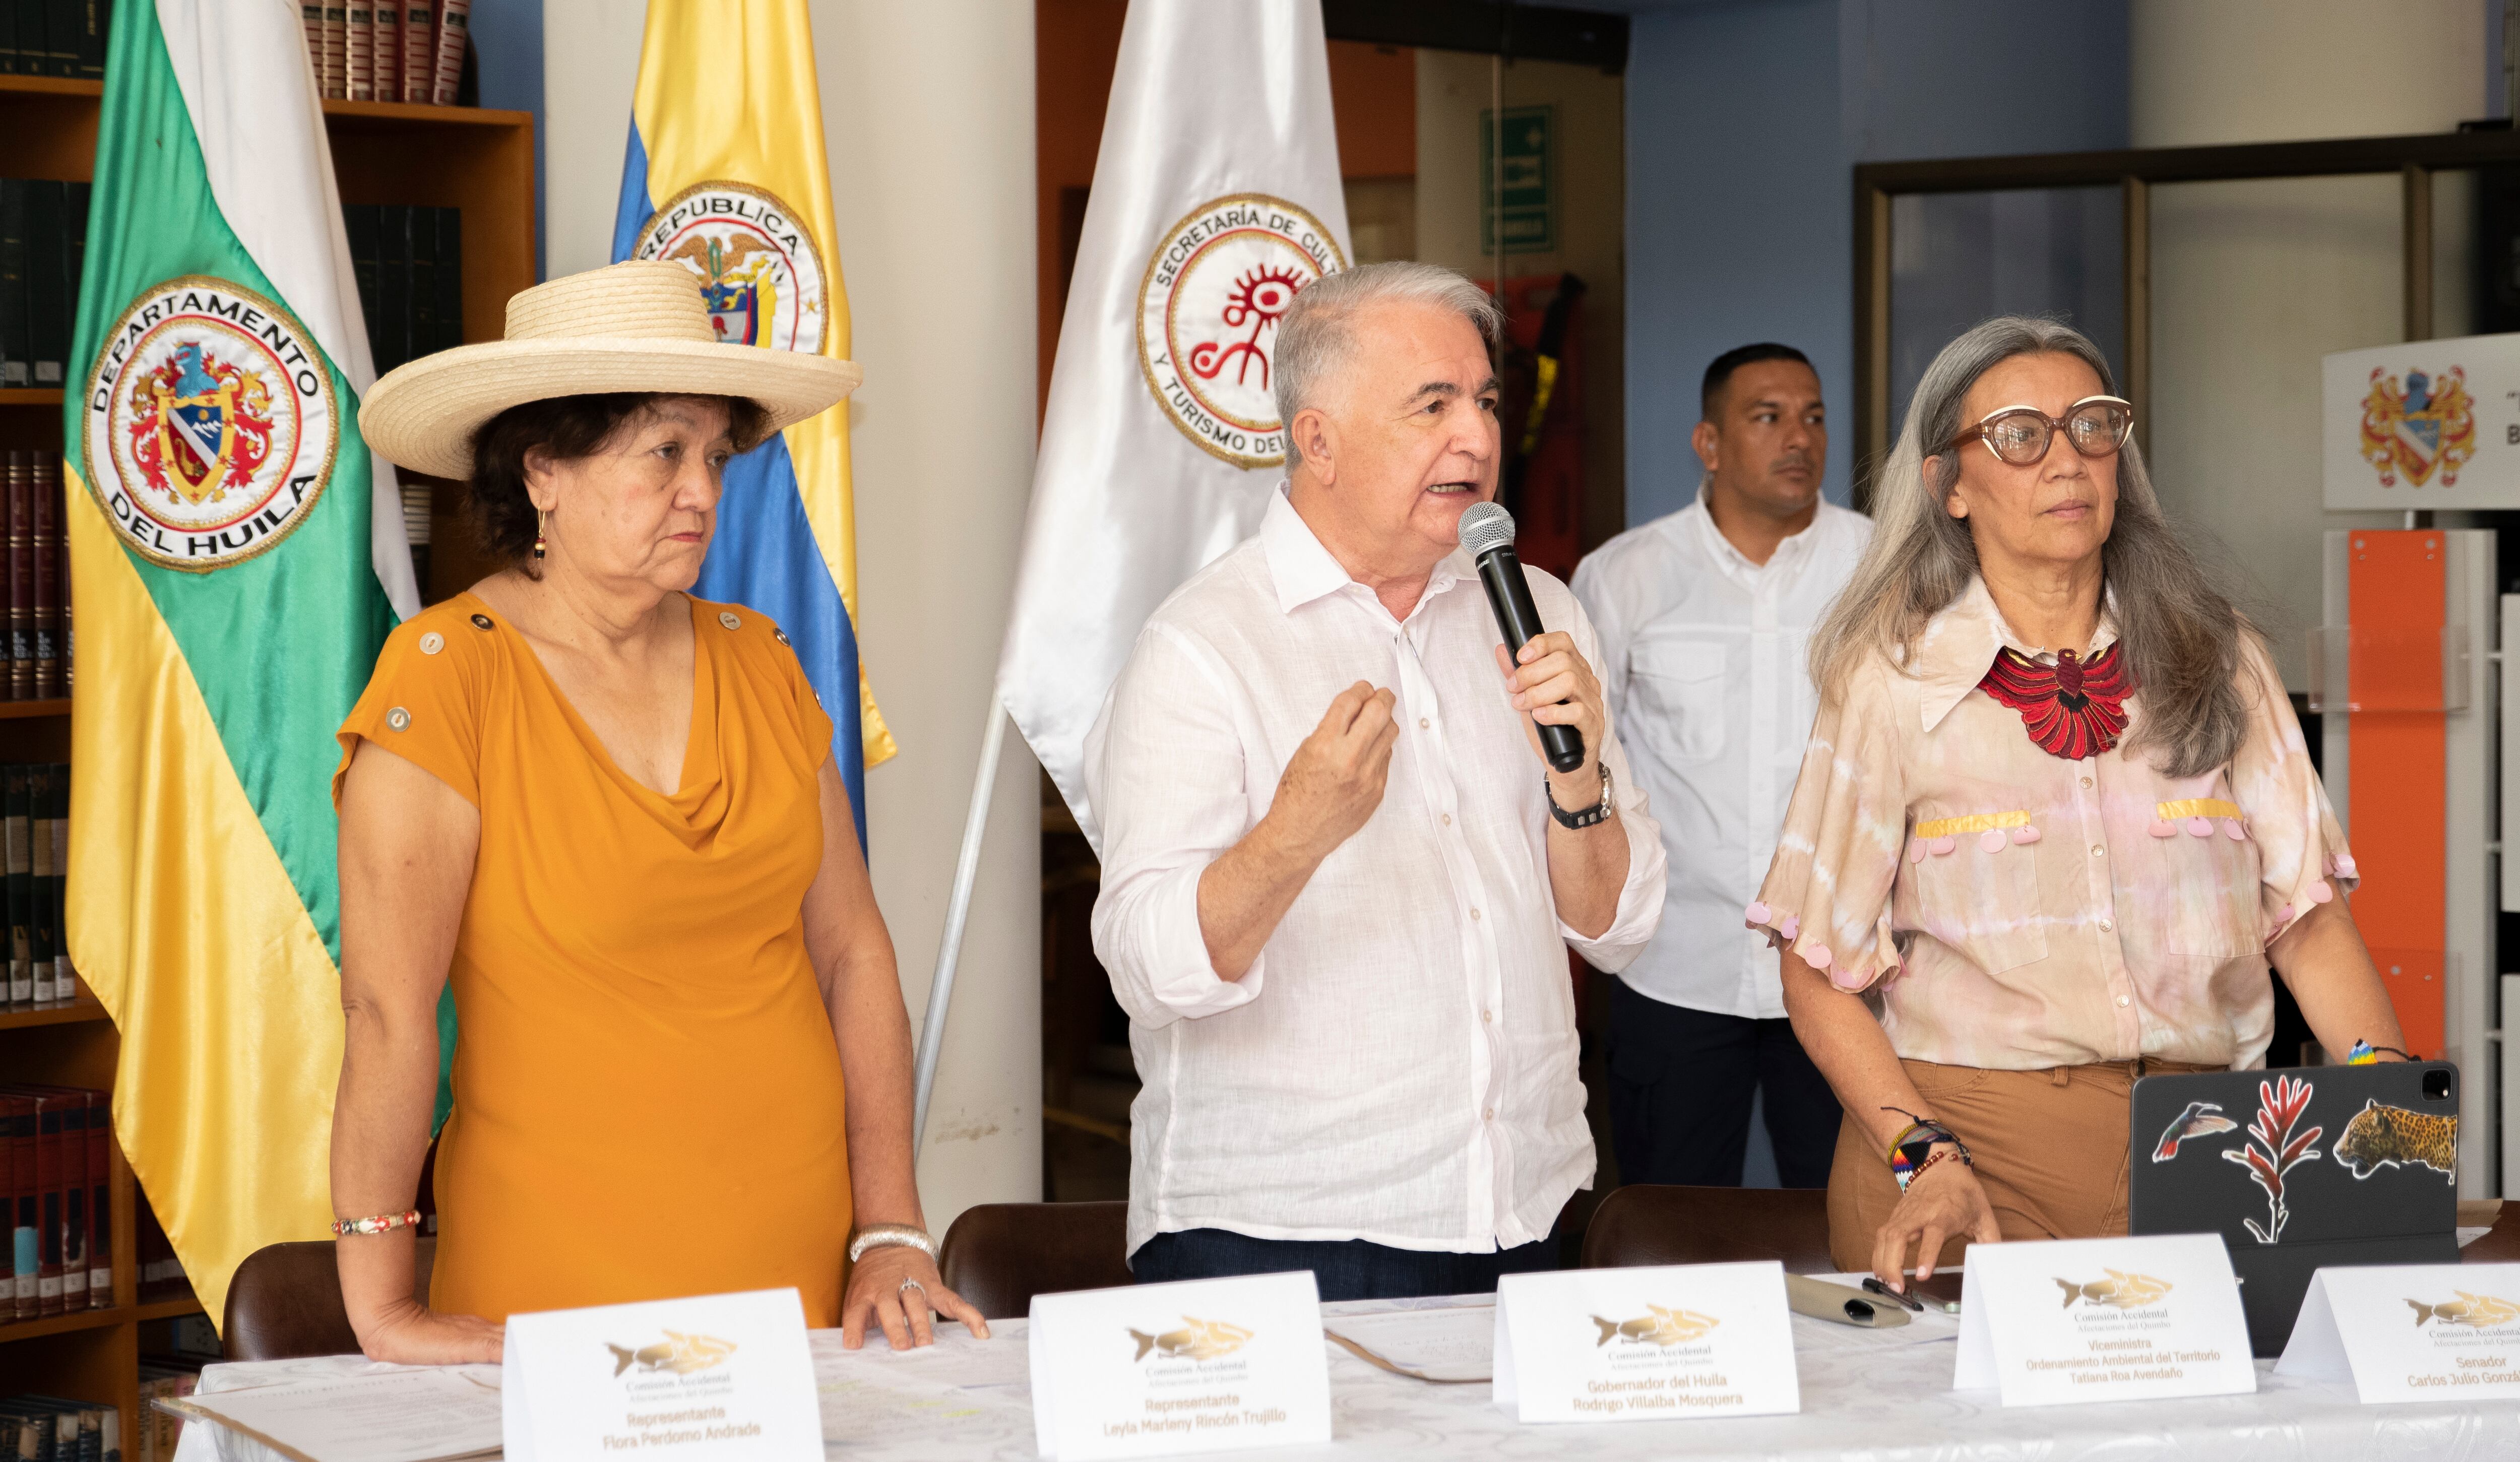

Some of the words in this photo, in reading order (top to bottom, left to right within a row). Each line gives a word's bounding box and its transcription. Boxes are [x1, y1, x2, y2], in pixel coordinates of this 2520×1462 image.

[640, 199, 798, 260] REPUBLICA
[1157, 204, 1261, 287] SECRETARÍA
[1269, 214, 1296, 236] DE
[94, 293, 319, 412] DEPARTAMENTO
[1155, 352, 1169, 366] Y
[1164, 377, 1245, 451] TURISMO
[111, 491, 173, 553] DEL
[188, 475, 317, 556] HUILA
[2074, 1311, 2118, 1322] Comisión
[2121, 1309, 2168, 1320] Accidental
[2077, 1324, 2125, 1333] Afectaciones
[2127, 1322, 2138, 1330] del
[2140, 1320, 2171, 1330] Quimbo
[2429, 1329, 2473, 1339] Comisión
[2476, 1327, 2520, 1337] Accidenta
[1608, 1350, 1656, 1361] Comisión
[1659, 1346, 1711, 1357] Accidental
[2088, 1338, 2152, 1351] Viceministra
[1146, 1363, 1192, 1377] Comisión
[1195, 1360, 1246, 1373] Accidental
[2027, 1356, 2099, 1371] Ordenamiento
[2102, 1353, 2154, 1367] Ambiental
[2156, 1351, 2172, 1363] del
[2173, 1349, 2220, 1363] Territorio
[2456, 1356, 2507, 1368] Senador
[1588, 1377, 1665, 1393] Gobernador
[1669, 1374, 1689, 1389] del
[1693, 1373, 1727, 1387] Huila
[2069, 1372, 2109, 1384] Tatiana
[2110, 1370, 2130, 1381] Roa
[2133, 1367, 2183, 1380] Avendaño
[2408, 1373, 2447, 1387] Carlos
[2449, 1372, 2480, 1385] Julio
[2482, 1370, 2520, 1383] Gonzá
[1145, 1394, 1240, 1414] Representante
[1572, 1397, 1623, 1413] Rodrigo
[1626, 1394, 1675, 1409] Villalba
[1679, 1393, 1743, 1408] Mosquera
[626, 1406, 726, 1428] Representante
[1104, 1422, 1138, 1438] Leyla
[1141, 1418, 1192, 1433] Marleny
[1196, 1412, 1239, 1429] Rincón
[1242, 1408, 1286, 1426] Trujillo
[603, 1435, 638, 1450] Flora
[641, 1429, 702, 1446] Perdomo
[706, 1422, 761, 1440] Andrade
